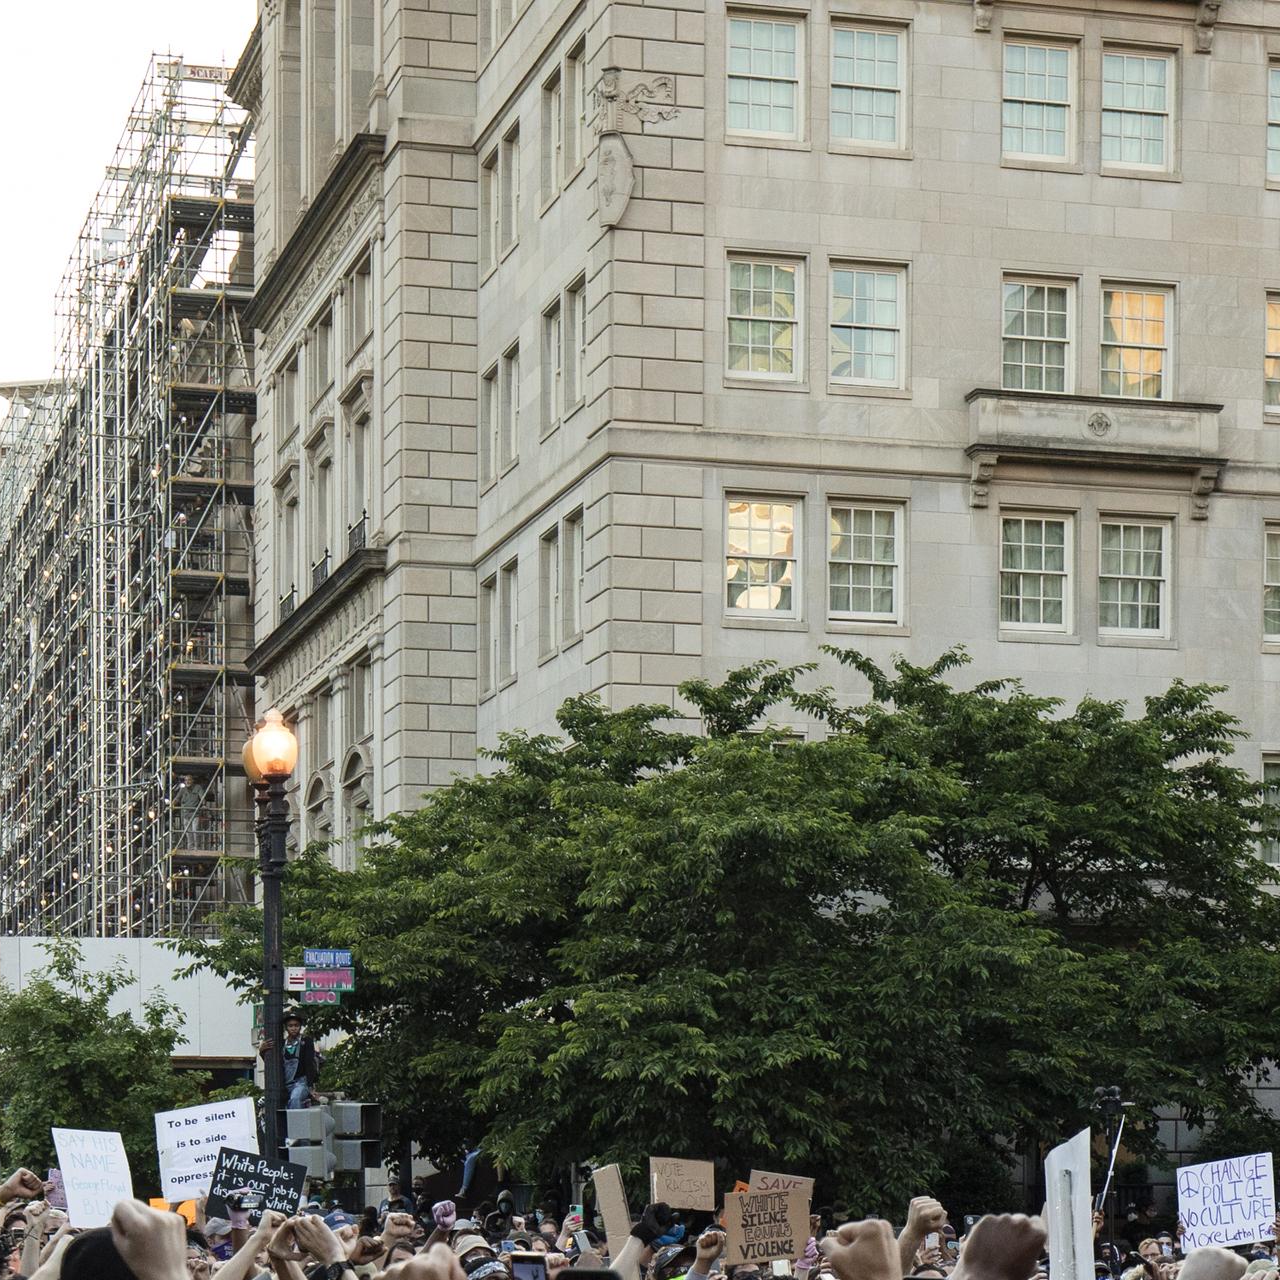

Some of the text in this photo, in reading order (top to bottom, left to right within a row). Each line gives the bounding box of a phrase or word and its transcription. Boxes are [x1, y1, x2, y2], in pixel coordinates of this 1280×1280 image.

[305, 952, 352, 965] EVACUATION ROUTE
[167, 1110, 236, 1129] To be silent
[57, 1132, 118, 1153] SAY HIS
[176, 1133, 228, 1149] is to side
[69, 1152, 119, 1174] NAME
[193, 1153, 217, 1164] with
[222, 1153, 294, 1184] White People:
[655, 1162, 685, 1178] VOTE
[1200, 1155, 1268, 1186] CHANGE
[216, 1169, 231, 1181] it
[232, 1173, 245, 1187] is
[269, 1183, 287, 1200] job
[287, 1187, 299, 1200] to
[664, 1177, 711, 1193] RACISM
[1202, 1178, 1264, 1206] POLICE
[265, 1197, 294, 1213] white
[738, 1191, 790, 1214] WHITE
[740, 1210, 788, 1229] SILENCE
[1180, 1198, 1275, 1229] NO CULTURE
[744, 1223, 793, 1243] EQUALS
[738, 1239, 795, 1260] VIOLENCE
